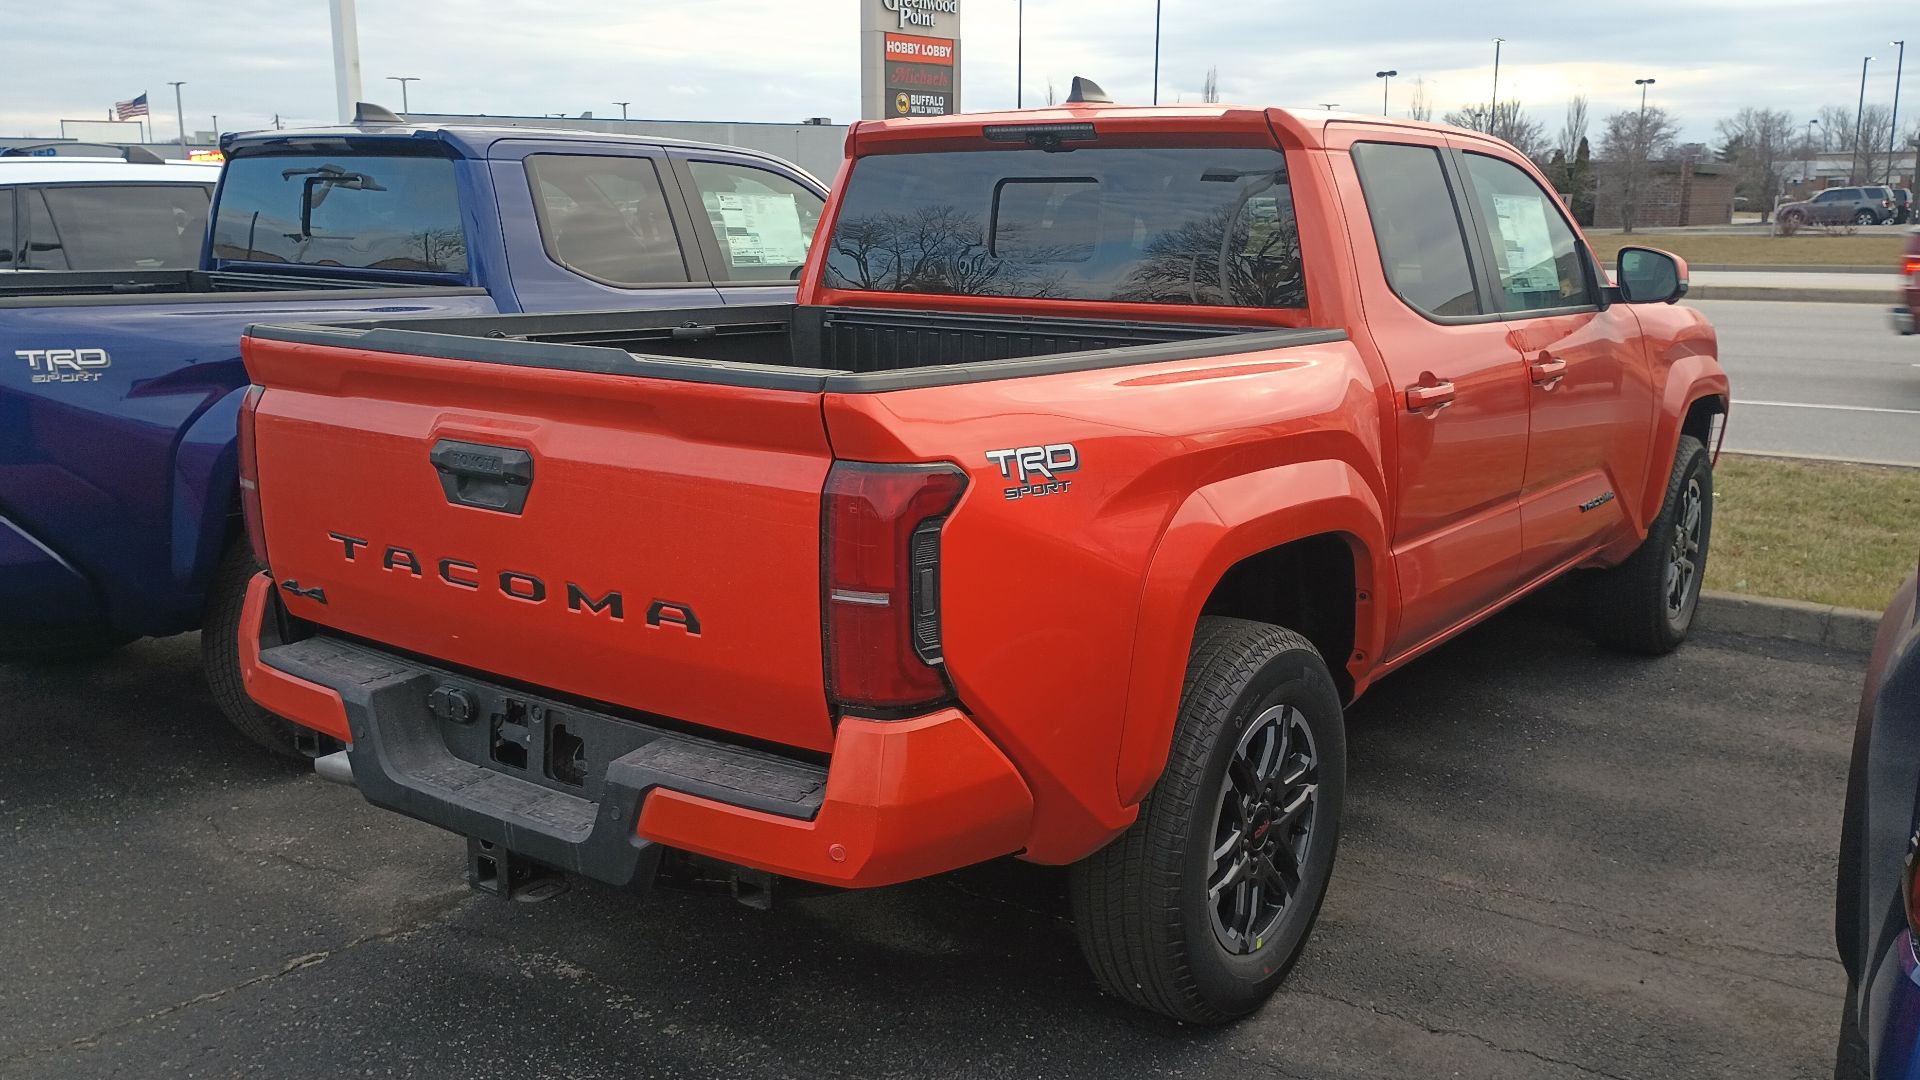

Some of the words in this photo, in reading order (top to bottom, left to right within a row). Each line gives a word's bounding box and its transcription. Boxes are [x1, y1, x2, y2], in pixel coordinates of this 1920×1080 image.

[898, 8, 936, 29] Point
[886, 41, 921, 55] HOBBY
[921, 44, 952, 58] LOBBY
[910, 94, 944, 107] BUFFALO
[911, 105, 926, 114] WILD
[926, 107, 944, 115] WINGS
[14, 348, 112, 372] TRD
[31, 371, 103, 384] SPORT
[985, 442, 1080, 484] TRD
[1003, 480, 1072, 500] SPORT
[328, 531, 701, 637] TACOMA
